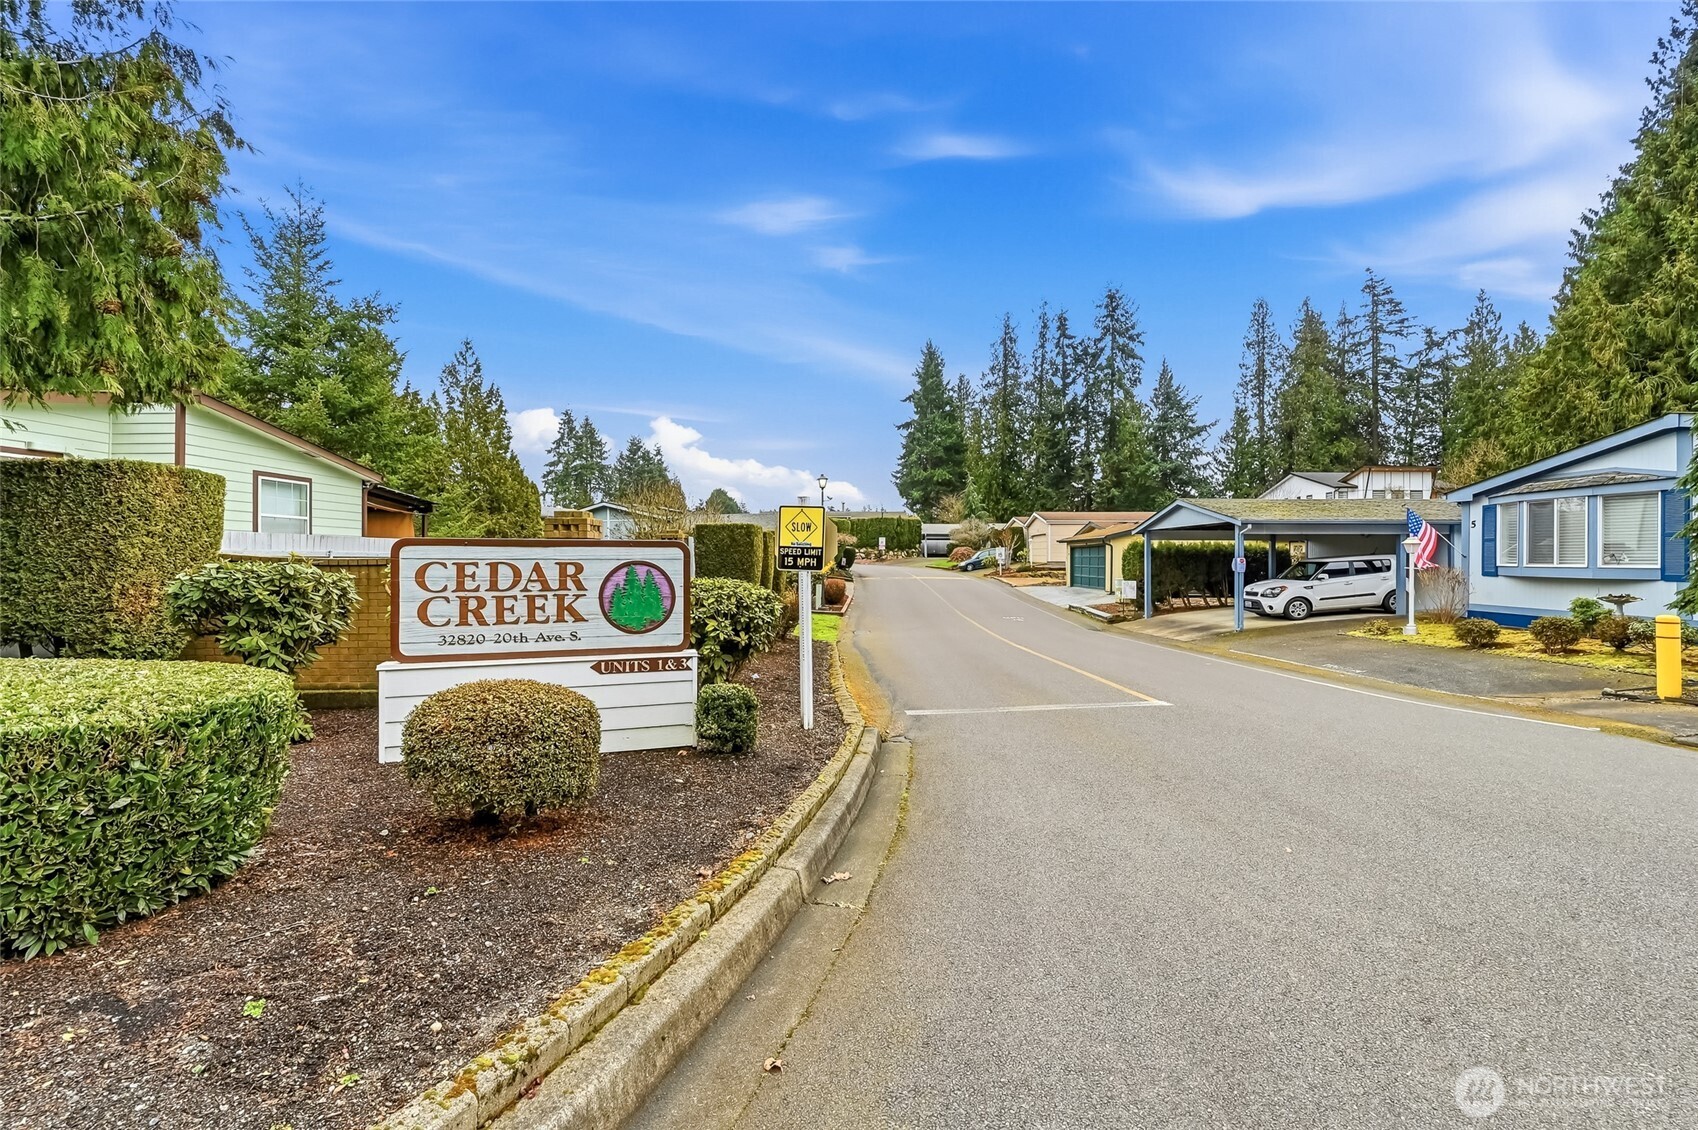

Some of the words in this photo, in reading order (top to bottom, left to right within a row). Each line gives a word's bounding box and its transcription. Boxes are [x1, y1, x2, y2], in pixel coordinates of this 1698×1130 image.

[791, 522, 812, 532] SLOW
[1471, 520, 1477, 529] 5
[784, 557, 794, 566] 15
[797, 558, 817, 566] MPH
[414, 561, 588, 593] CEDAR
[417, 593, 589, 627] CREEK
[438, 634, 486, 646] 32820
[493, 632, 530, 644] 20th
[534, 632, 566, 643] Ave.
[569, 630, 582, 641] S.
[600, 660, 650, 674] UNITS
